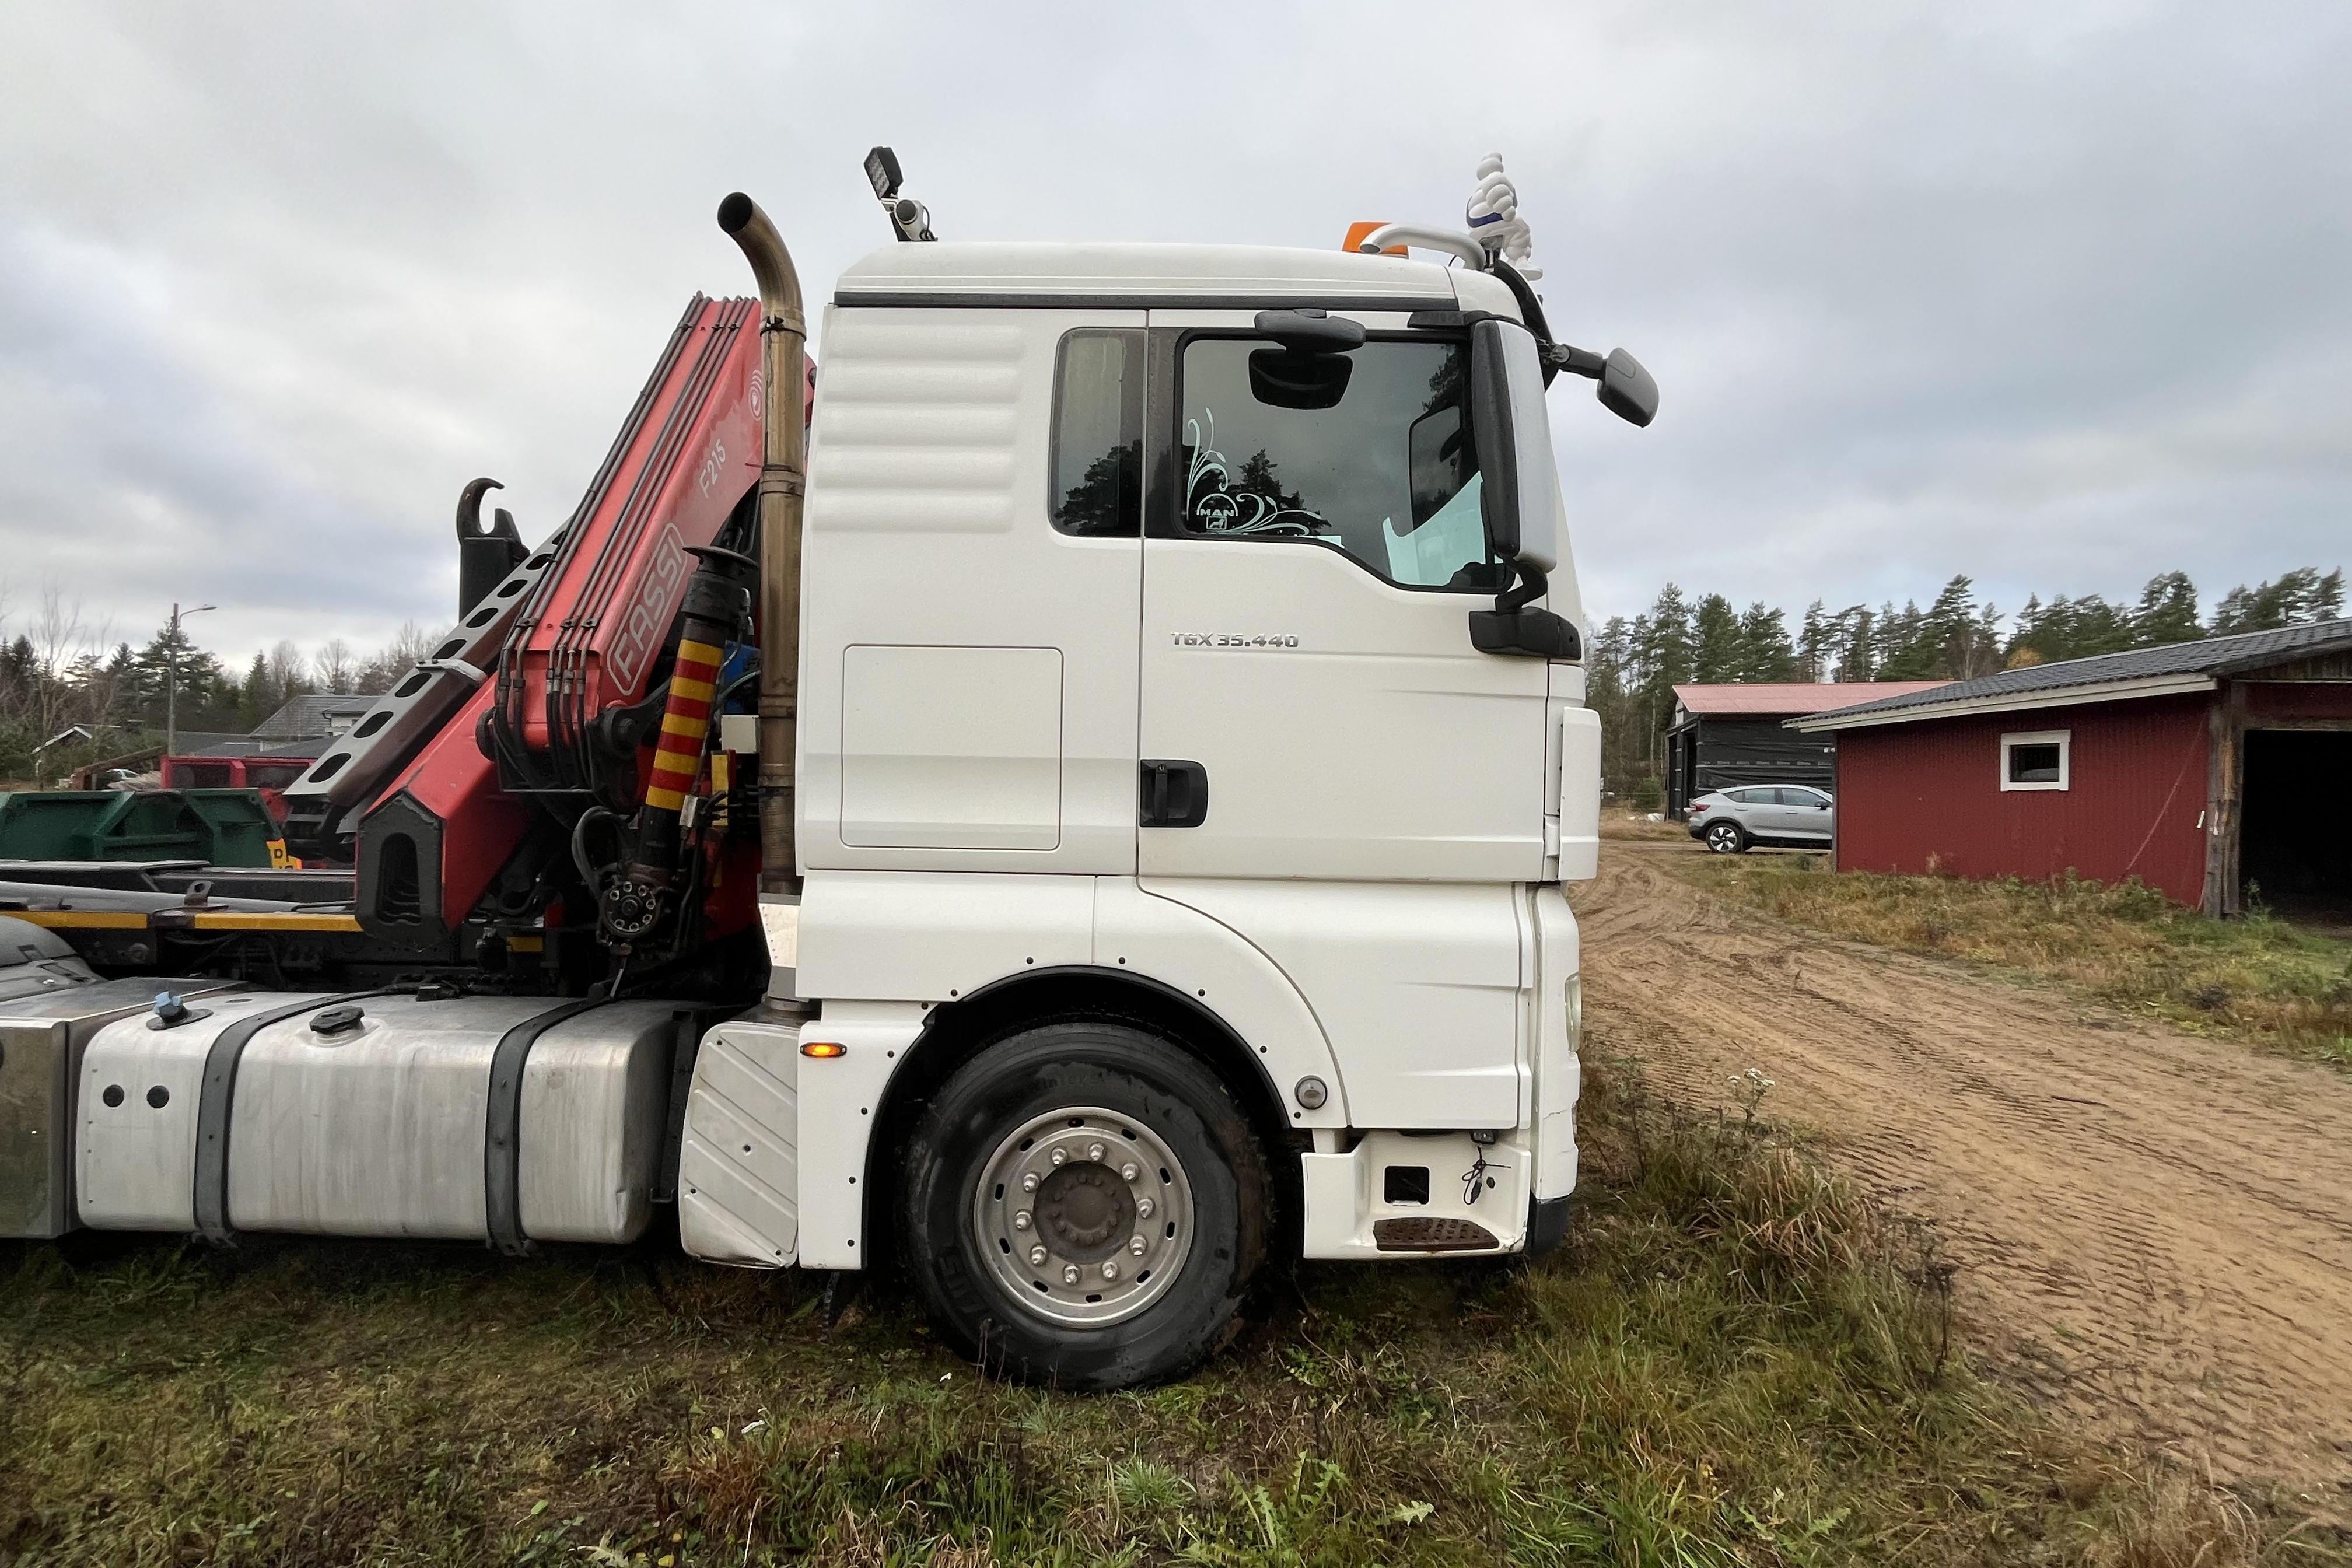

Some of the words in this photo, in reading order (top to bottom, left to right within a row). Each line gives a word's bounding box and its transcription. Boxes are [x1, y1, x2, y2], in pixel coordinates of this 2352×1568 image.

[699, 438, 726, 499] F215
[1200, 508, 1234, 517] MAN
[614, 536, 682, 681] FASSI
[1171, 632, 1213, 646] TGX
[1217, 633, 1300, 648] 35.440
